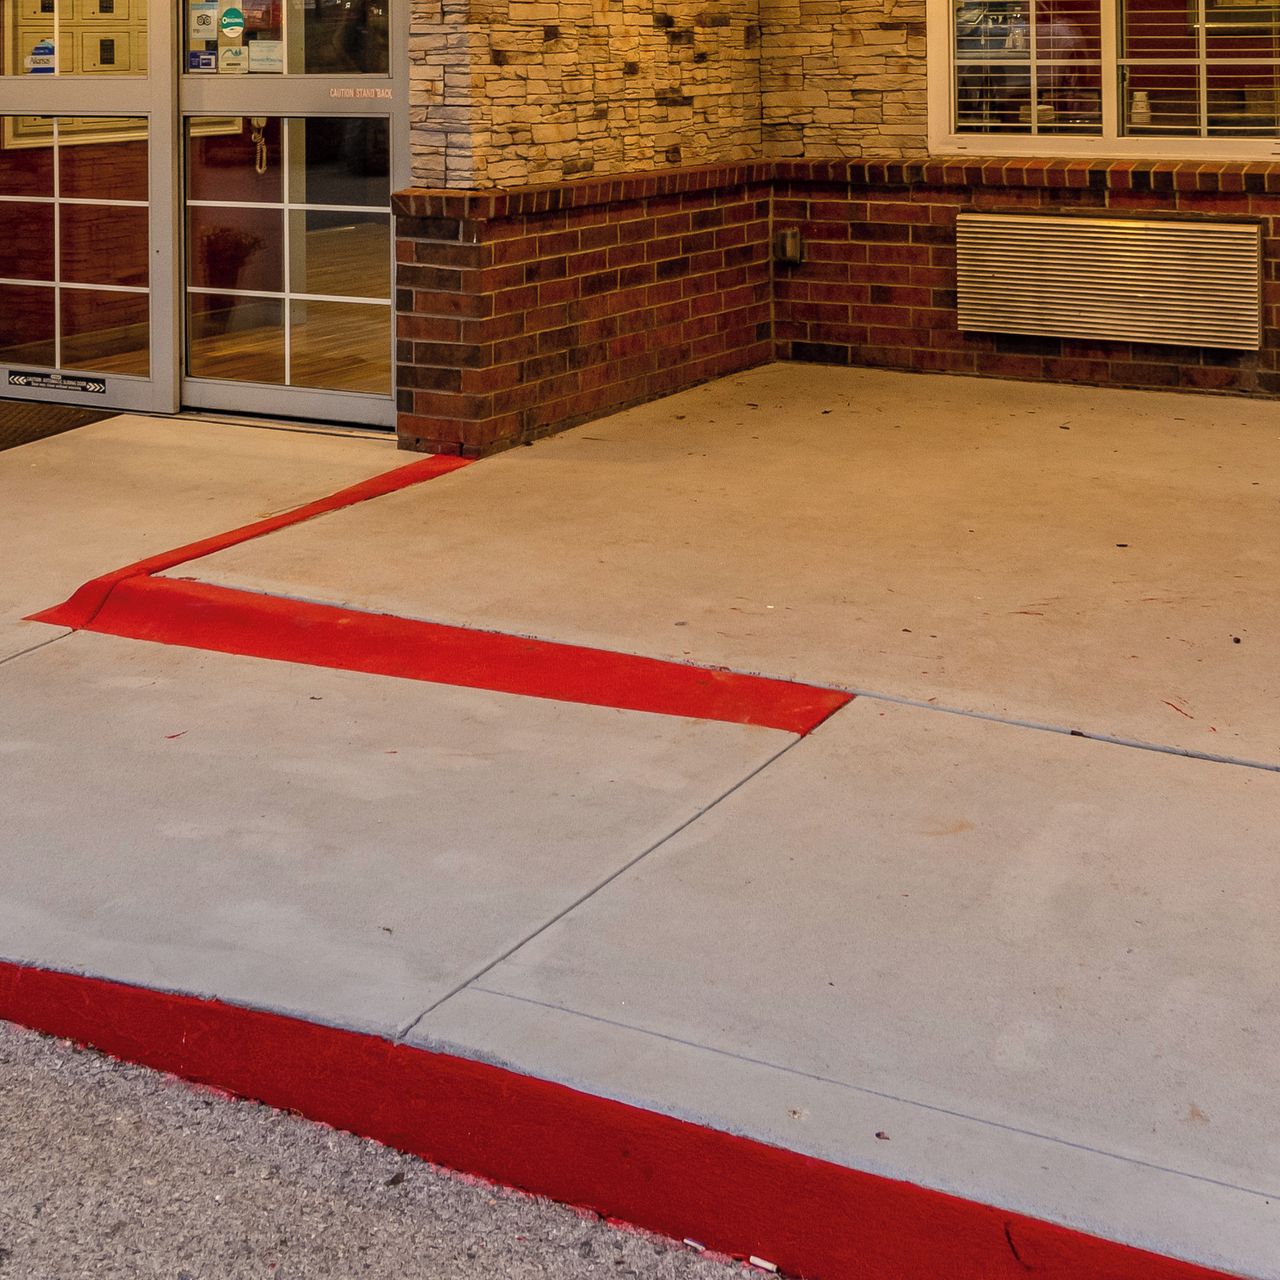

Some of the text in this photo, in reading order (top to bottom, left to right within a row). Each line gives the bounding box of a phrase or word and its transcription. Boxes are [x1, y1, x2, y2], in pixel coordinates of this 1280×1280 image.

[329, 87, 393, 99] CAUTION STAND BACK
